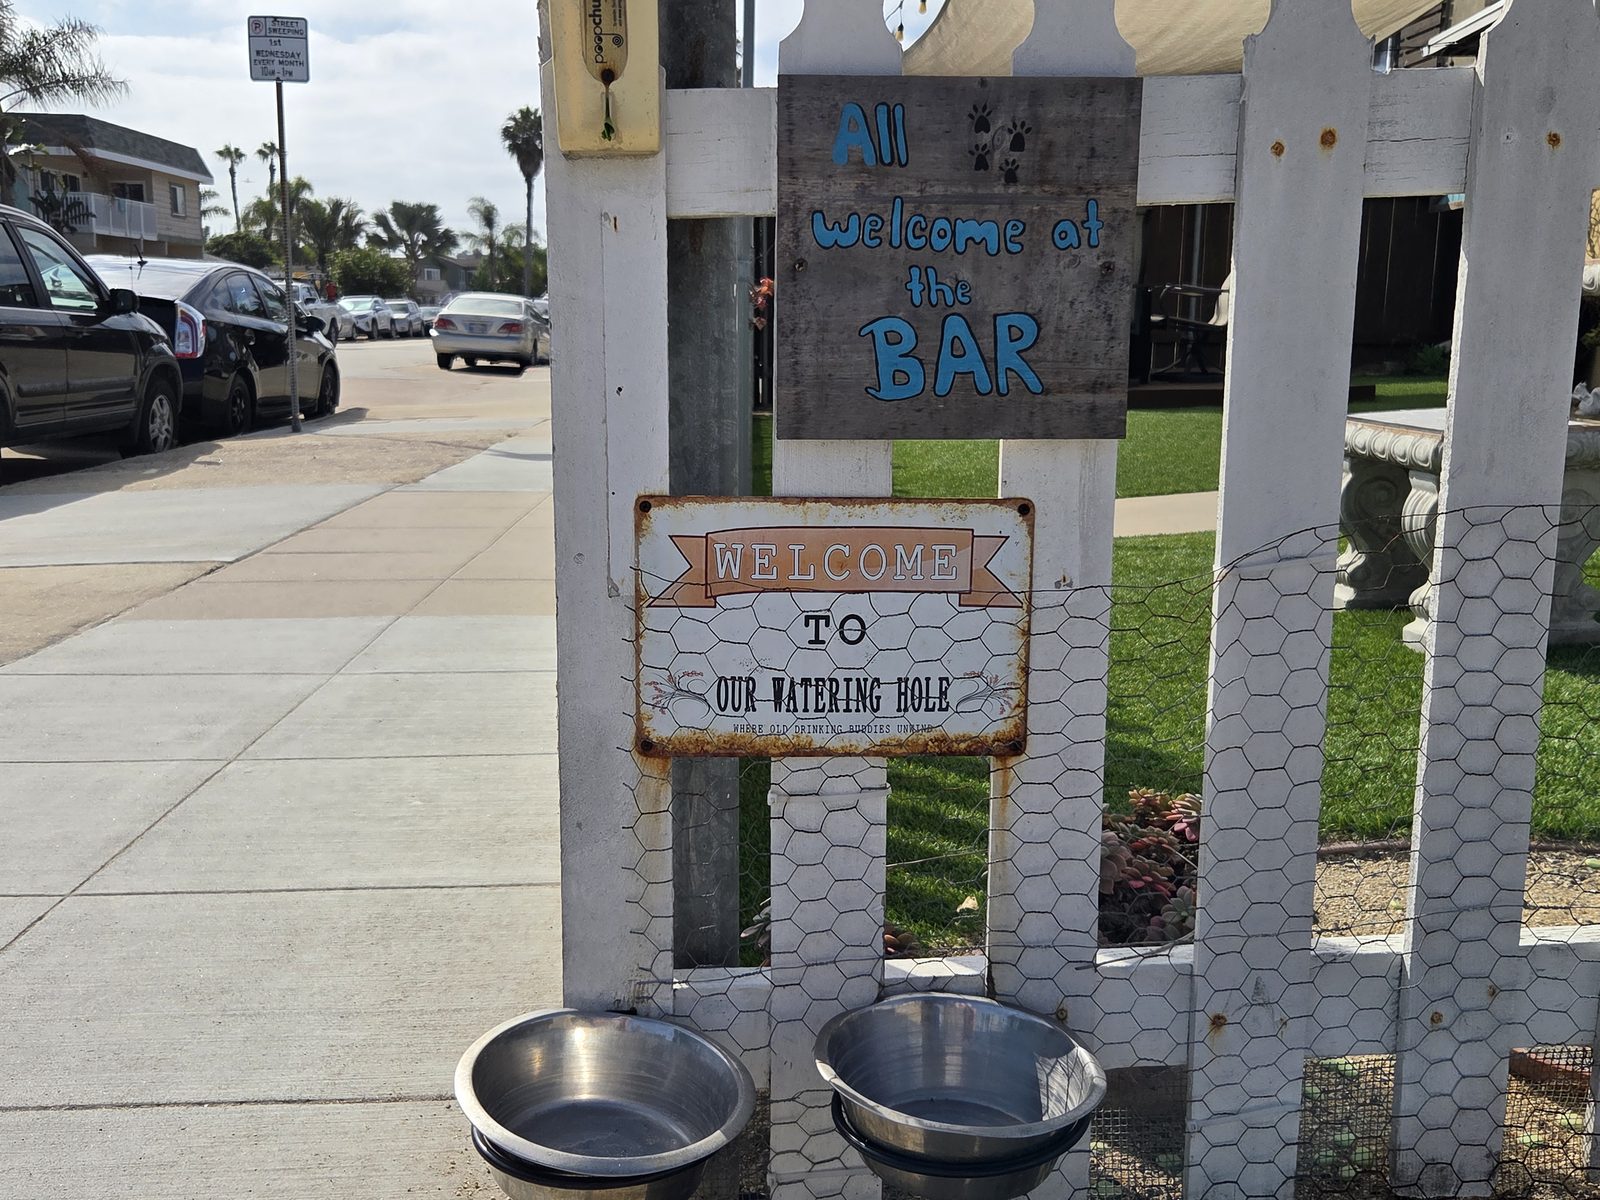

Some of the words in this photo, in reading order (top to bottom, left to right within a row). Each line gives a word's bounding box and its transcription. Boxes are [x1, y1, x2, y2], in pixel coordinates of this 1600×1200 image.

[255, 50, 301, 59] WEDNESDAY
[831, 102, 909, 168] All
[811, 197, 1026, 256] welcome
[1052, 199, 1104, 250] at
[906, 266, 972, 307] the
[859, 313, 1044, 400] BAR
[713, 543, 959, 582] WELCOME
[804, 613, 868, 646] TO
[716, 676, 757, 713] OUR
[772, 676, 882, 713] WATERING
[896, 676, 950, 713] HOLE
[733, 723, 763, 734] WHERE
[769, 724, 788, 734] OLD
[794, 724, 842, 734] DRINKING
[849, 724, 890, 734] BUDDIES
